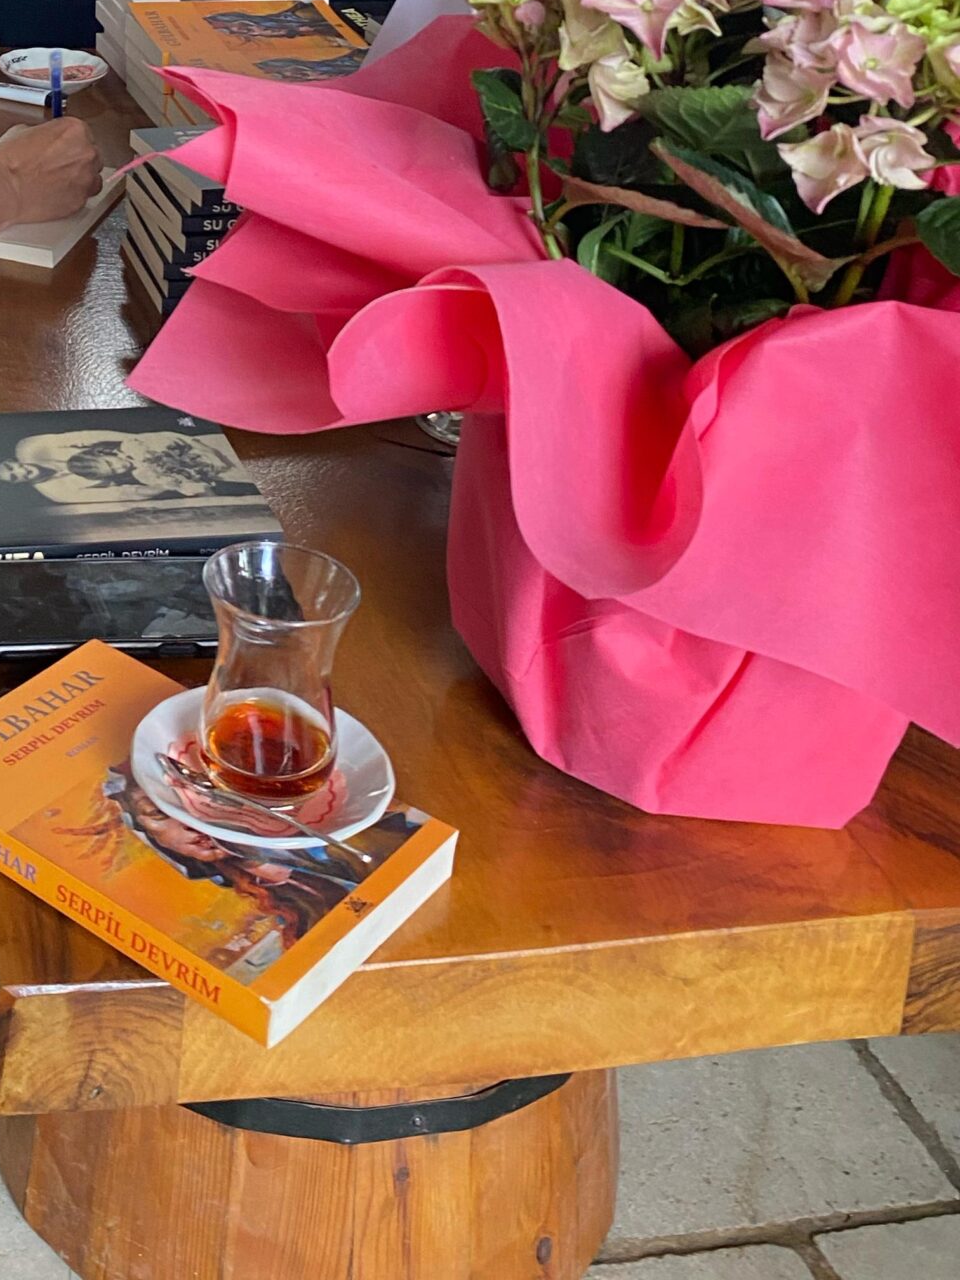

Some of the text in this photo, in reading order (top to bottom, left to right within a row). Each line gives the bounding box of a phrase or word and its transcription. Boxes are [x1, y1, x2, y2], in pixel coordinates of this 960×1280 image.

[203, 219, 222, 231] SU
[2, 732, 54, 766] SERPİL
[56, 884, 125, 942] SERPİL
[131, 933, 221, 1003] DEVRİM
